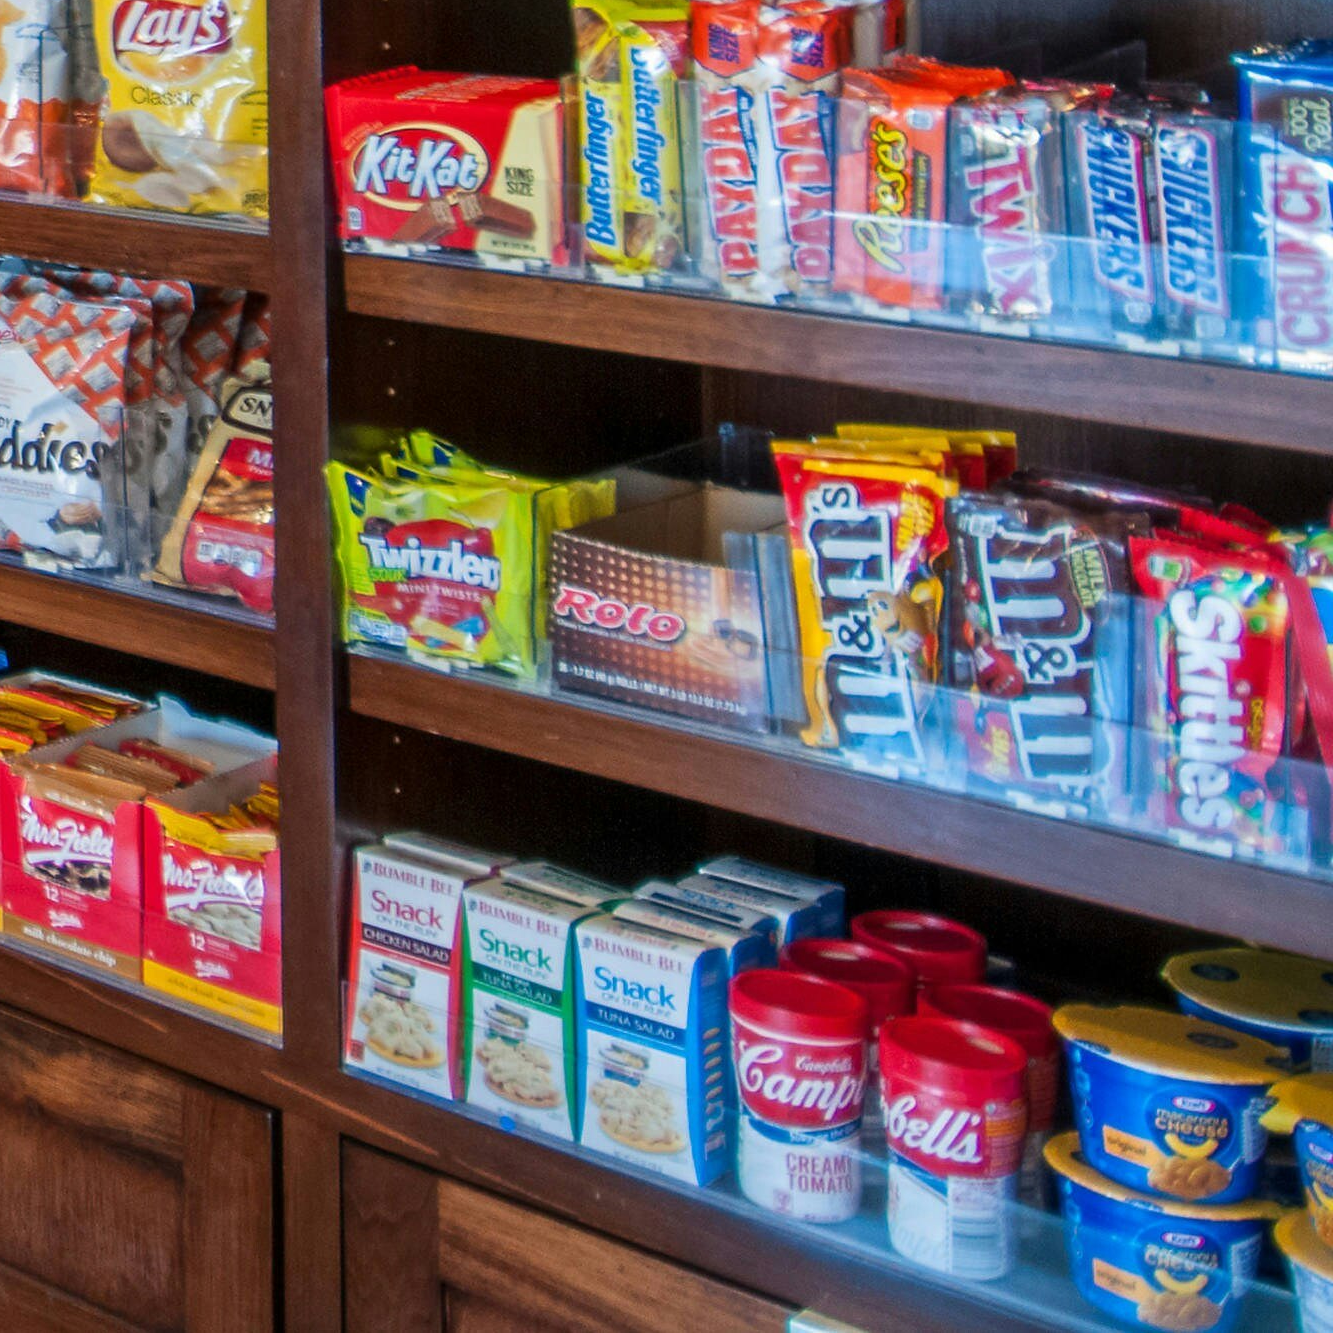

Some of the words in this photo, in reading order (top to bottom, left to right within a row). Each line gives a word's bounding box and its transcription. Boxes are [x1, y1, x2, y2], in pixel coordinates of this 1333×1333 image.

[116, 0, 226, 63] Lay's
[710, 22, 723, 64] KING
[504, 166, 534, 183] KING
[507, 179, 535, 197] SIZE
[584, 90, 617, 248] Butterfinger
[699, 86, 760, 278] PAYDAY
[359, 532, 501, 593] Twizzlers
[397, 582, 430, 595] MINI
[434, 585, 481, 603] TWISTS
[553, 584, 686, 642] Rolo
[1169, 587, 1247, 831] Skittles
[43, 885, 59, 902] 12
[373, 861, 426, 889] BUMBLE
[430, 877, 454, 896] BEE
[371, 890, 443, 931] Snack
[478, 899, 532, 929] BUMBLE
[536, 918, 560, 937] BEE
[23, 925, 45, 941] milk
[46, 933, 91, 960] chocolate
[92, 947, 117, 967] chip
[190, 932, 205, 950] 12
[363, 926, 410, 952] CHICKEN
[411, 939, 450, 963] SALAD
[479, 928, 552, 973] Snack
[593, 936, 653, 966] BUMBLE
[658, 953, 684, 973] BEE
[483, 972, 514, 993] TUNA
[516, 982, 552, 1005] SALAD
[594, 967, 675, 1011] Snack
[597, 1008, 631, 1028] TUNA
[633, 1017, 676, 1041] SALAD
[1181, 1099, 1208, 1110] Kraft
